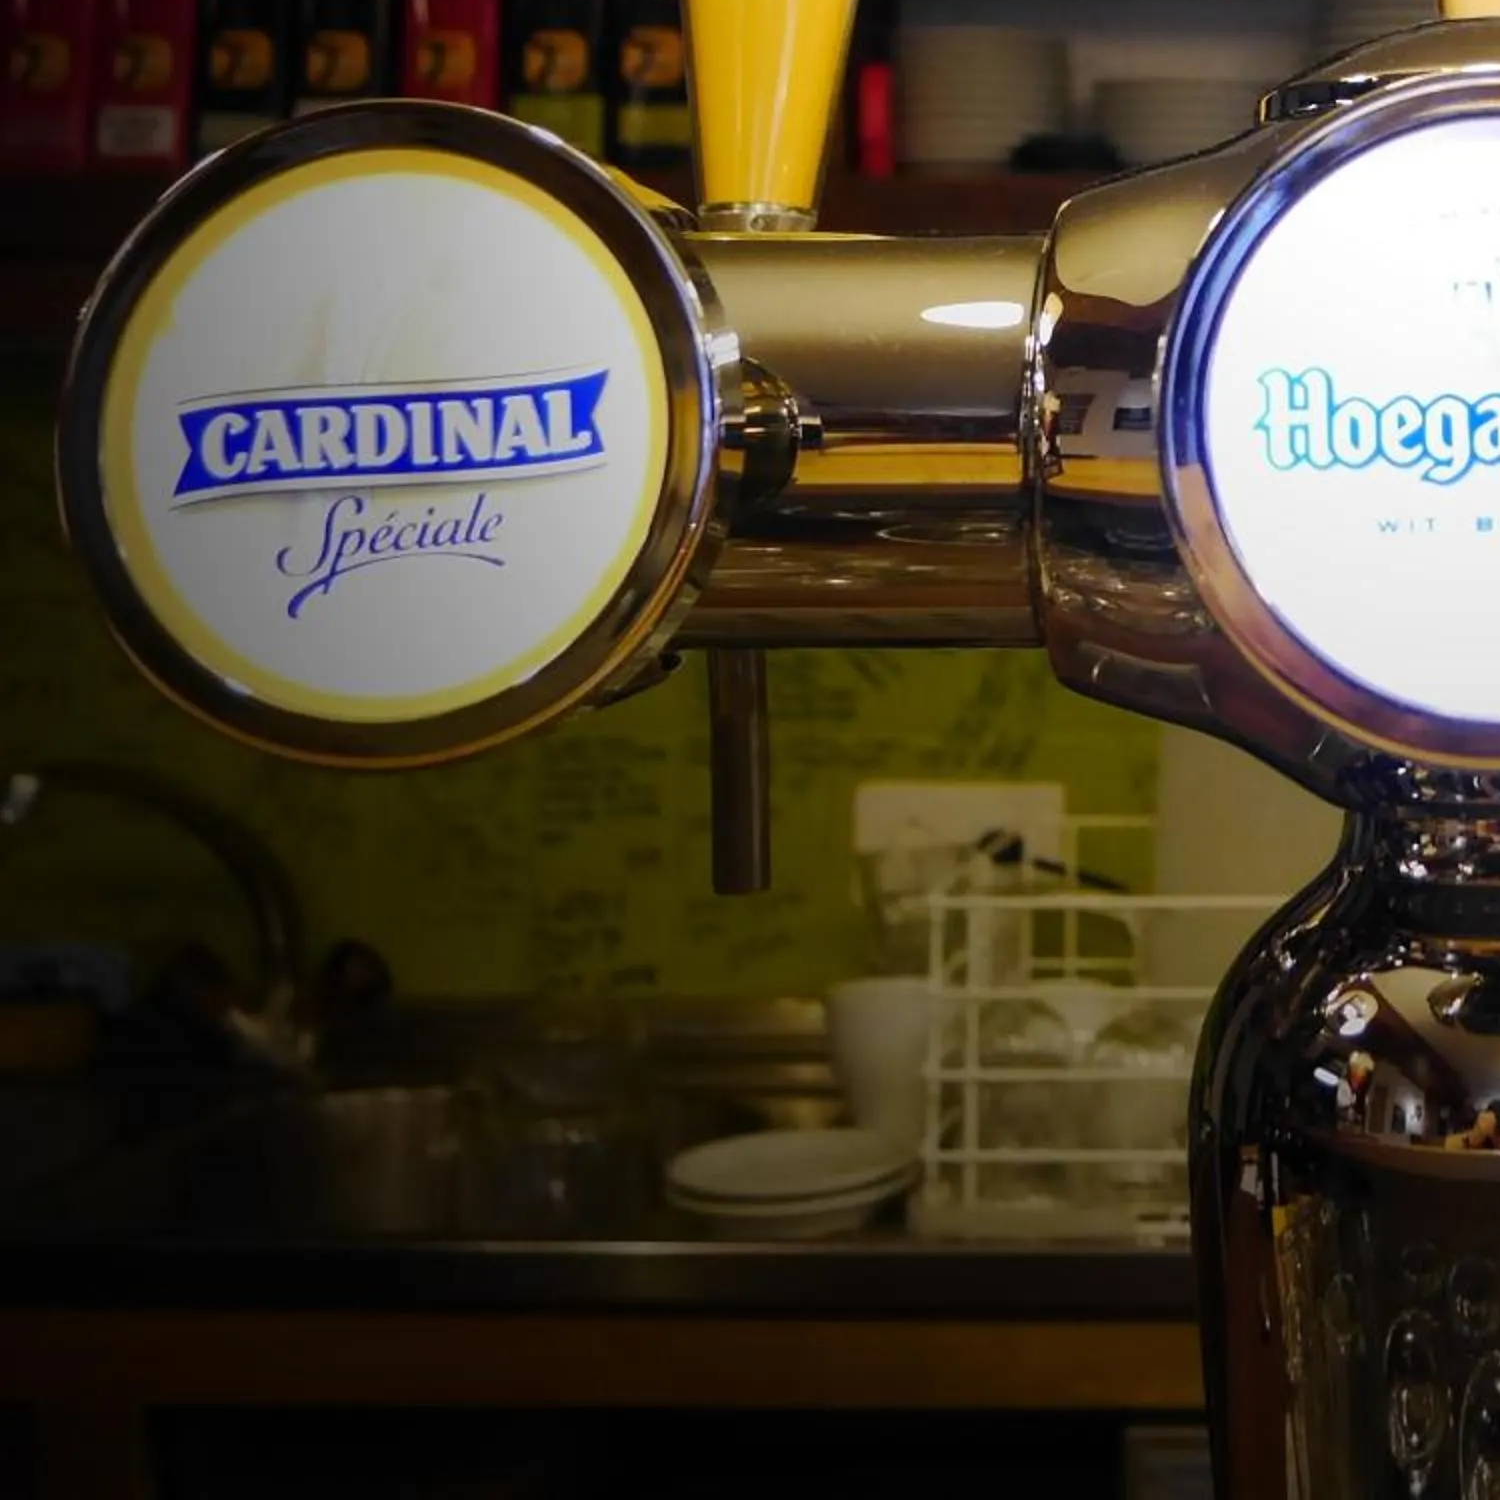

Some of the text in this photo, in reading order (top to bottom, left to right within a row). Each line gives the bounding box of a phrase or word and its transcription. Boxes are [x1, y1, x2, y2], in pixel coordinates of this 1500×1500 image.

[201, 389, 593, 480] CARDINAL
[276, 493, 506, 619] Spéciale
[1378, 516, 1437, 534] WIT
